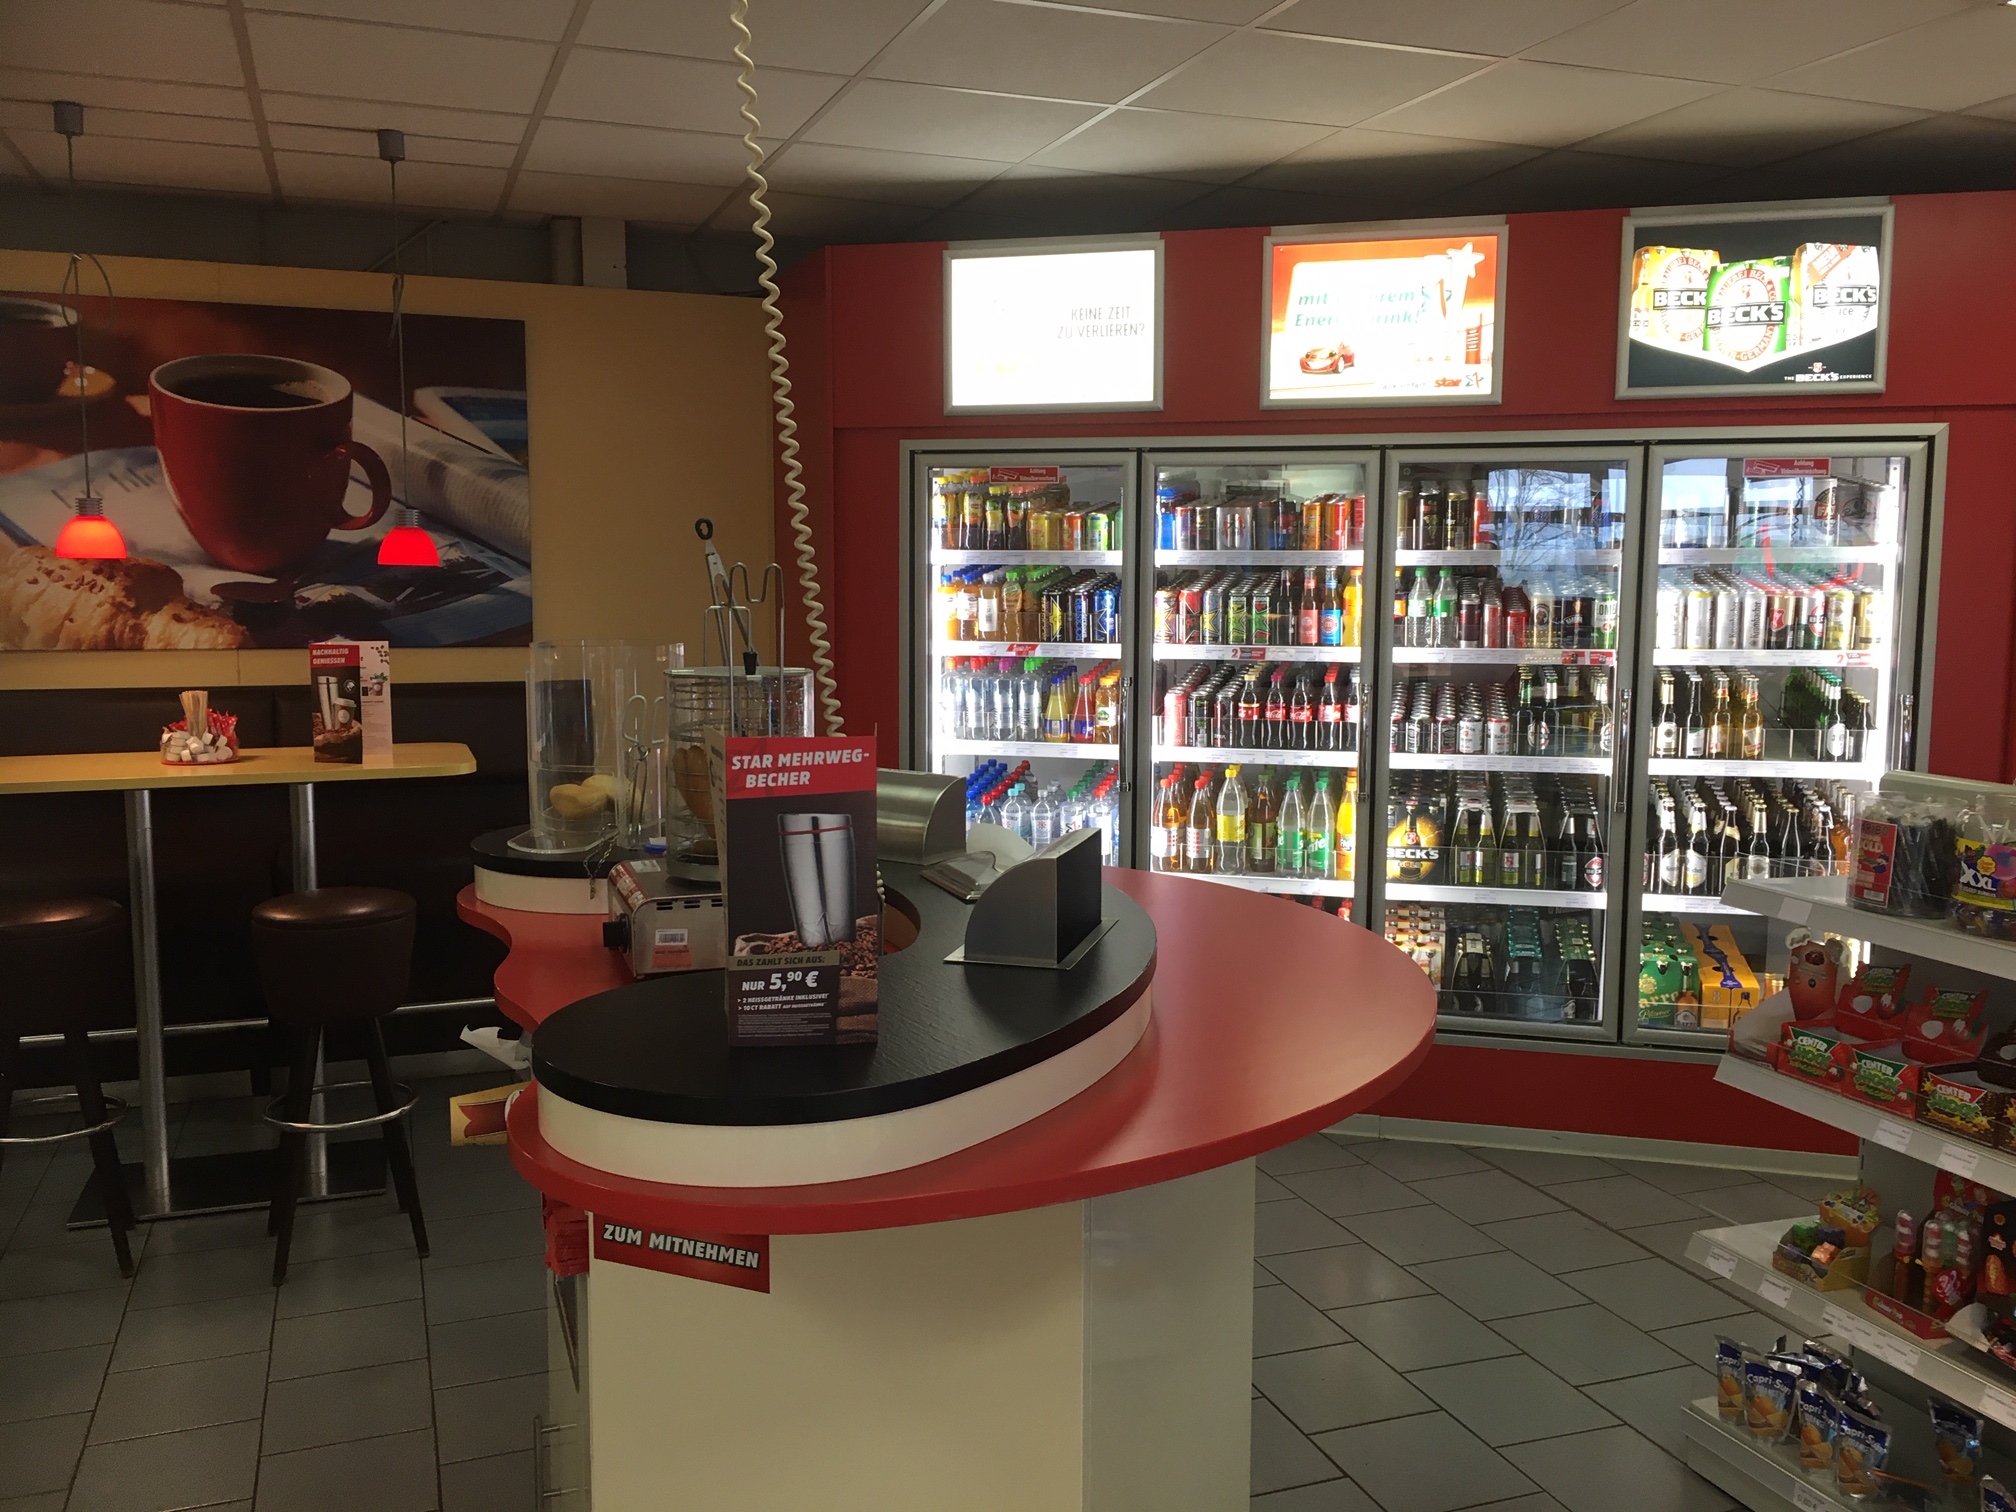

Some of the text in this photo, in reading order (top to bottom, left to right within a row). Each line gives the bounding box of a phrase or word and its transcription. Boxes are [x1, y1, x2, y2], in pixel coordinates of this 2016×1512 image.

[1298, 292, 1328, 306] mit
[1654, 291, 1707, 307] BECK
[1814, 286, 1877, 304] BECK'S
[1071, 305, 1131, 321] KEINE ZEIT
[1707, 303, 1784, 325] BECK'S
[1057, 322, 1146, 339] ZU VERLIEREN?
[1434, 377, 1462, 388] star
[1795, 371, 1839, 382] BECK'S
[1750, 601, 1762, 639] Krombacher
[731, 748, 870, 770] STAR MEHRWEG-
[745, 771, 811, 788] BECHER
[1960, 860, 1997, 892] XXL
[736, 958, 754, 967] DAS
[784, 956, 804, 965] SICH
[805, 956, 826, 964] AUS:
[741, 970, 819, 992] NUR 5,90 €
[1797, 1036, 1828, 1053] CENTER
[1861, 1059, 1894, 1077] CENTER
[1936, 1083, 1972, 1102] CENTER
[603, 1223, 760, 1269] ZUM MITNEHMEN
[1717, 1353, 1741, 1367] Capri
[1746, 1373, 1792, 1396] Capri-Sun
